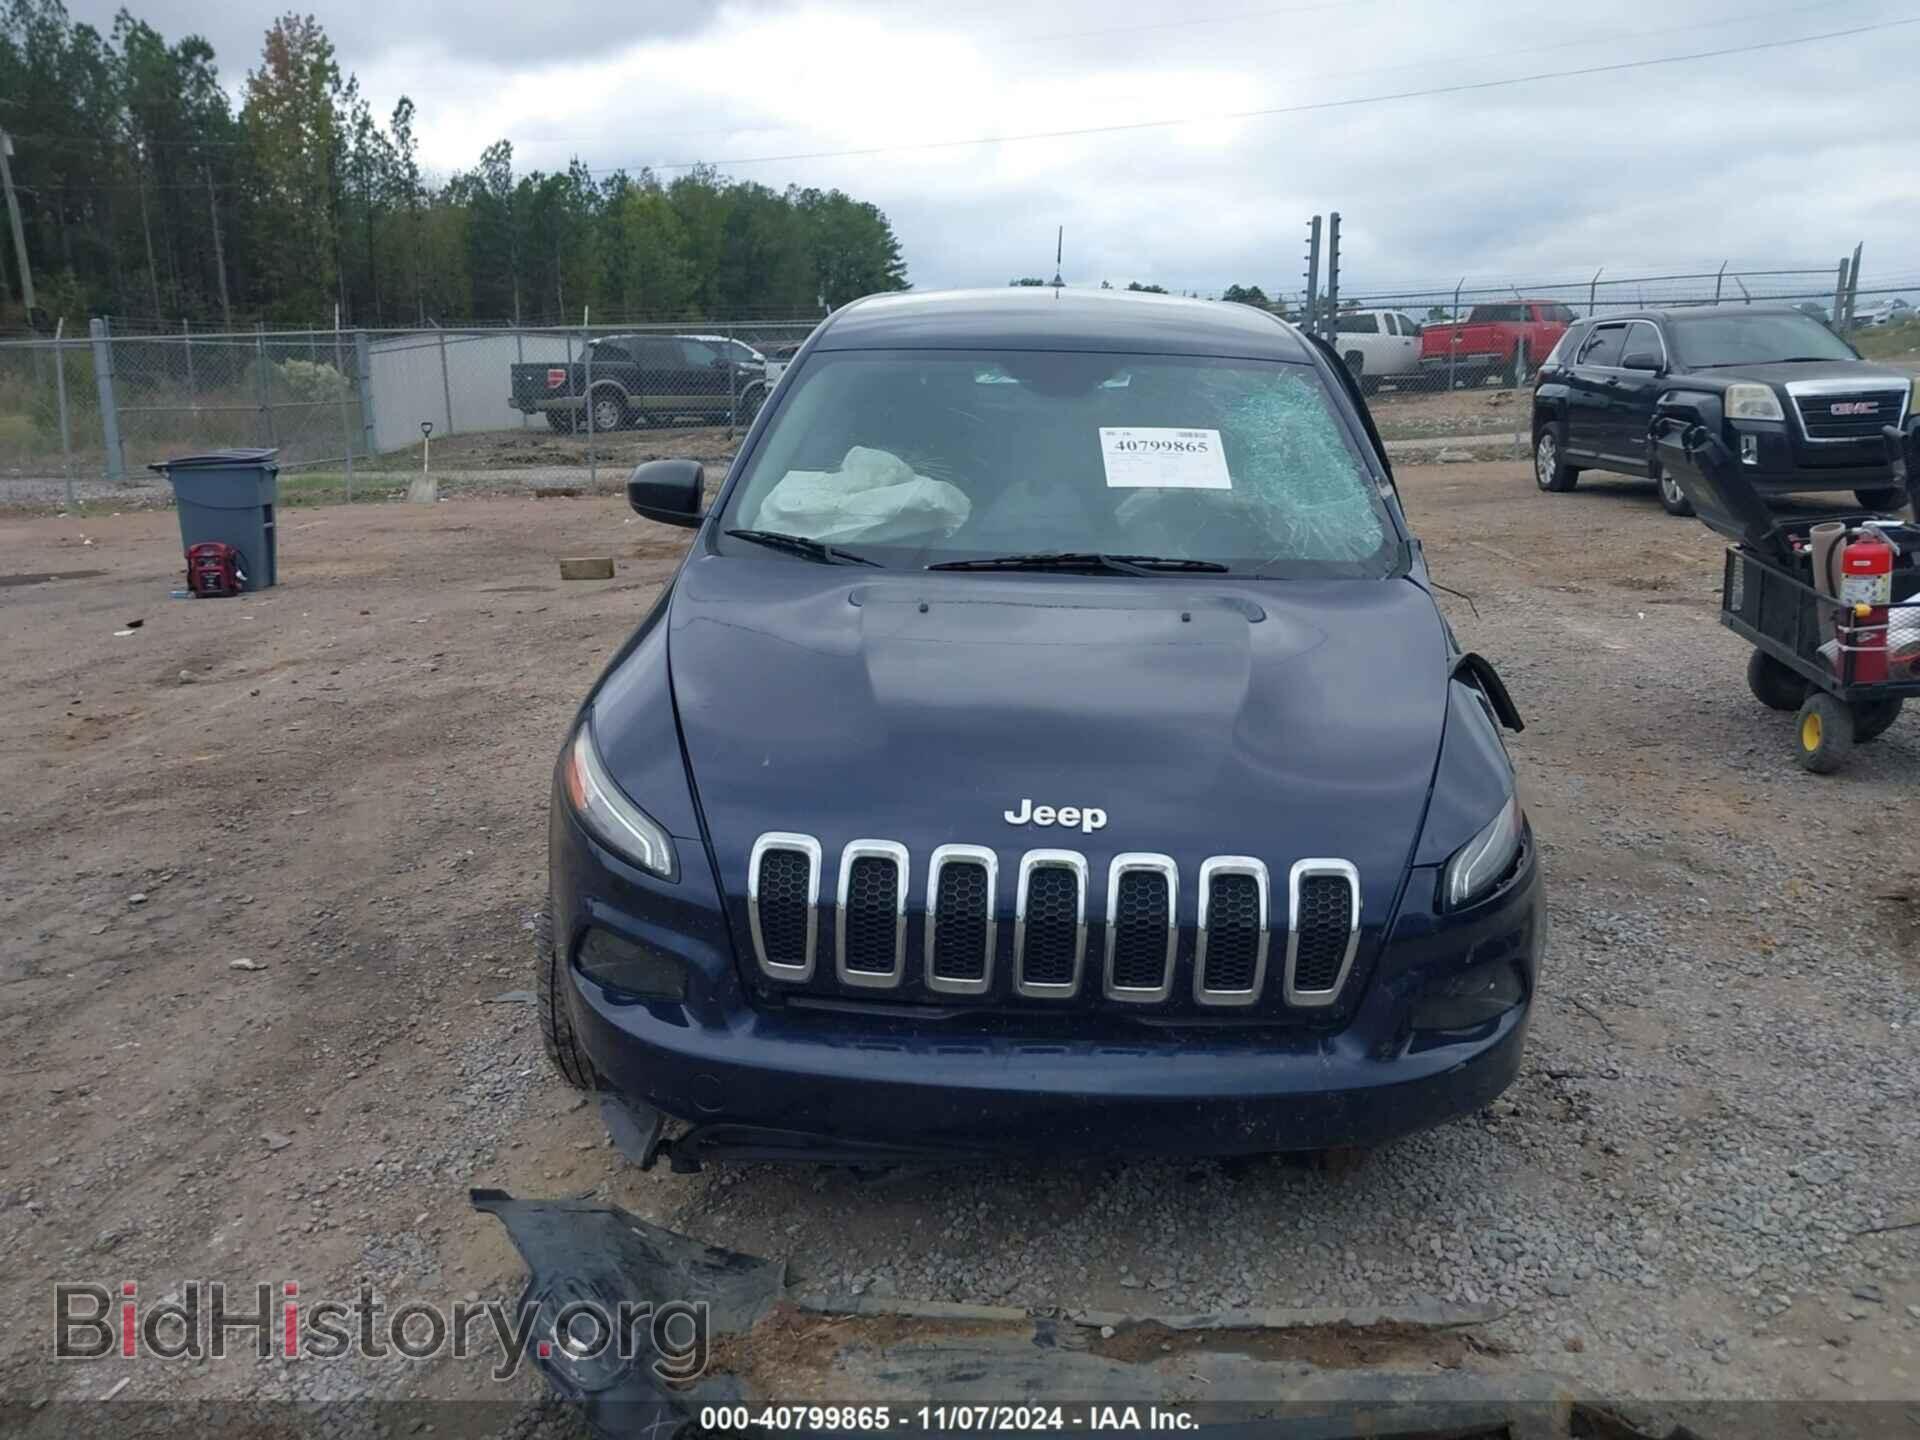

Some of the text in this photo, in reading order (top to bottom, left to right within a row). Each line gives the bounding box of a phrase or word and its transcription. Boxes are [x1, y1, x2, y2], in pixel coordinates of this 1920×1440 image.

[1831, 402, 1879, 415] GMC
[1114, 439, 1208, 453] 40799865
[1004, 799, 1107, 833] Jeep
